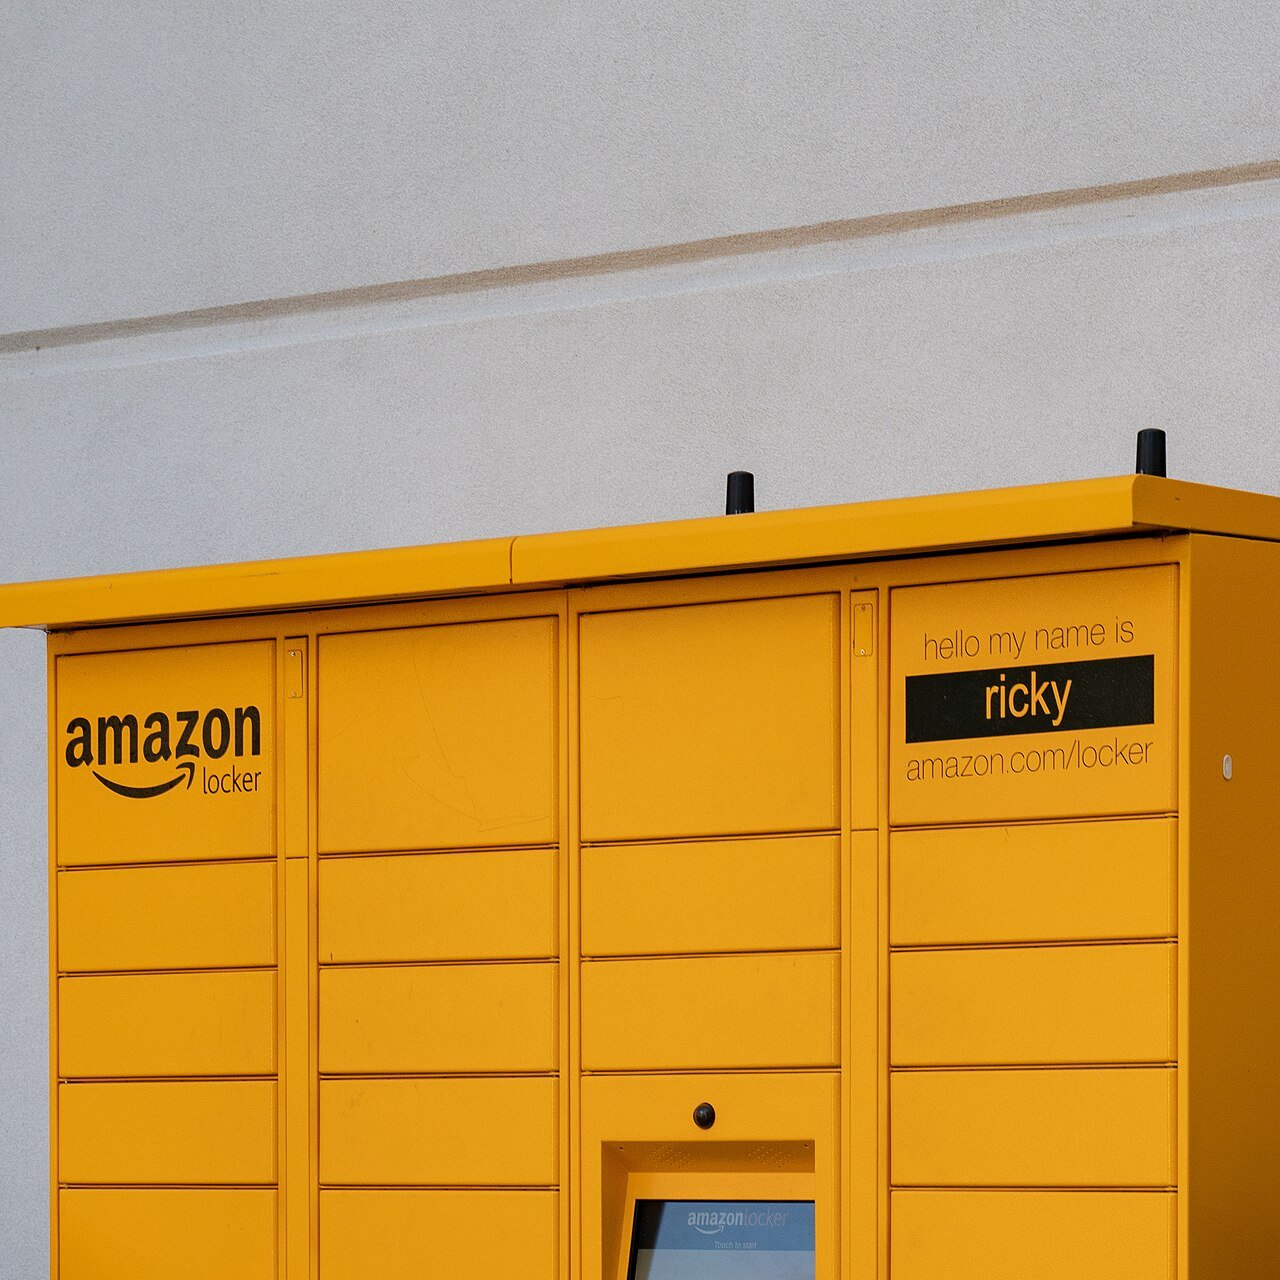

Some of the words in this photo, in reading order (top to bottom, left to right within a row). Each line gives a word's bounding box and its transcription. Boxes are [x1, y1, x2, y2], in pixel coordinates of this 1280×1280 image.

[924, 630, 980, 660] hello
[990, 630, 1026, 660] my
[1036, 623, 1105, 650] name
[1116, 616, 1134, 644] is
[986, 671, 1072, 727] ricky
[65, 705, 261, 768] amazon
[203, 765, 262, 794] locker
[906, 737, 1154, 782] amazon.com/locker
[714, 1240, 733, 1249] Touch
[734, 1240, 742, 1249] to
[742, 1240, 757, 1250] start
